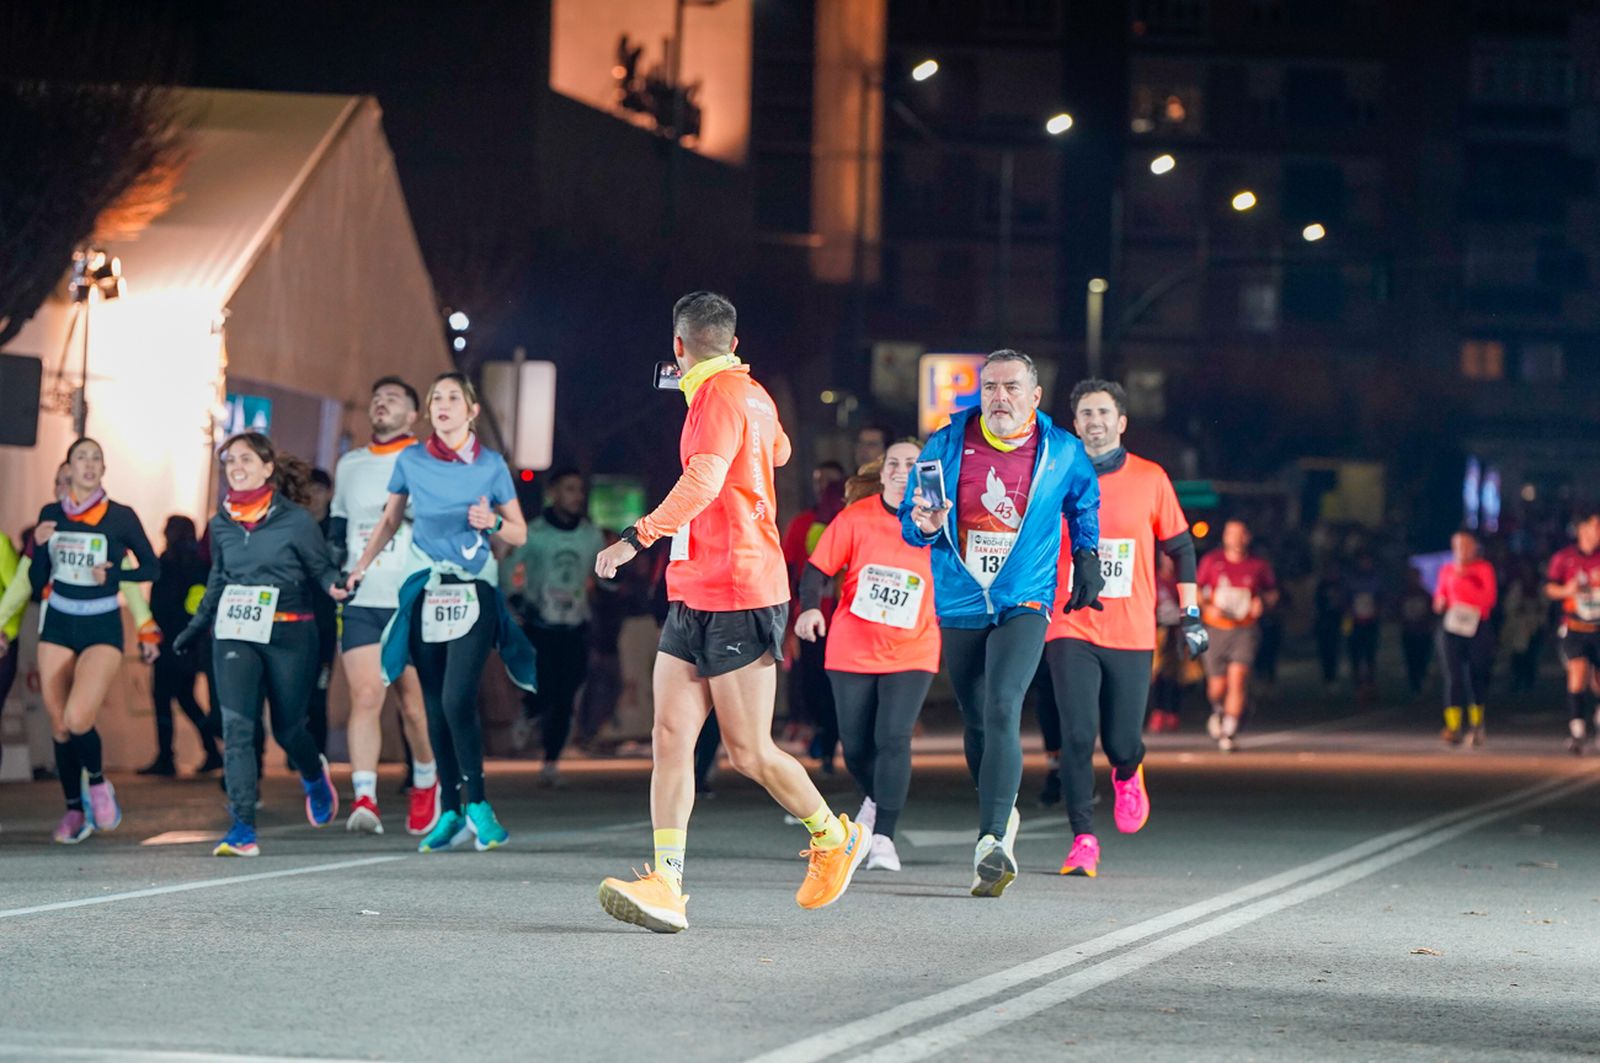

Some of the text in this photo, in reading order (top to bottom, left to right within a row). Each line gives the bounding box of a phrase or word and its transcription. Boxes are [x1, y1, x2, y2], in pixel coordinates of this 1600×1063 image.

[934, 363, 979, 408] P
[994, 502, 1013, 520] 43
[980, 555, 1005, 573] 13
[869, 583, 910, 607] 5437
[227, 604, 262, 622] 4583
[435, 604, 468, 622] 6167
